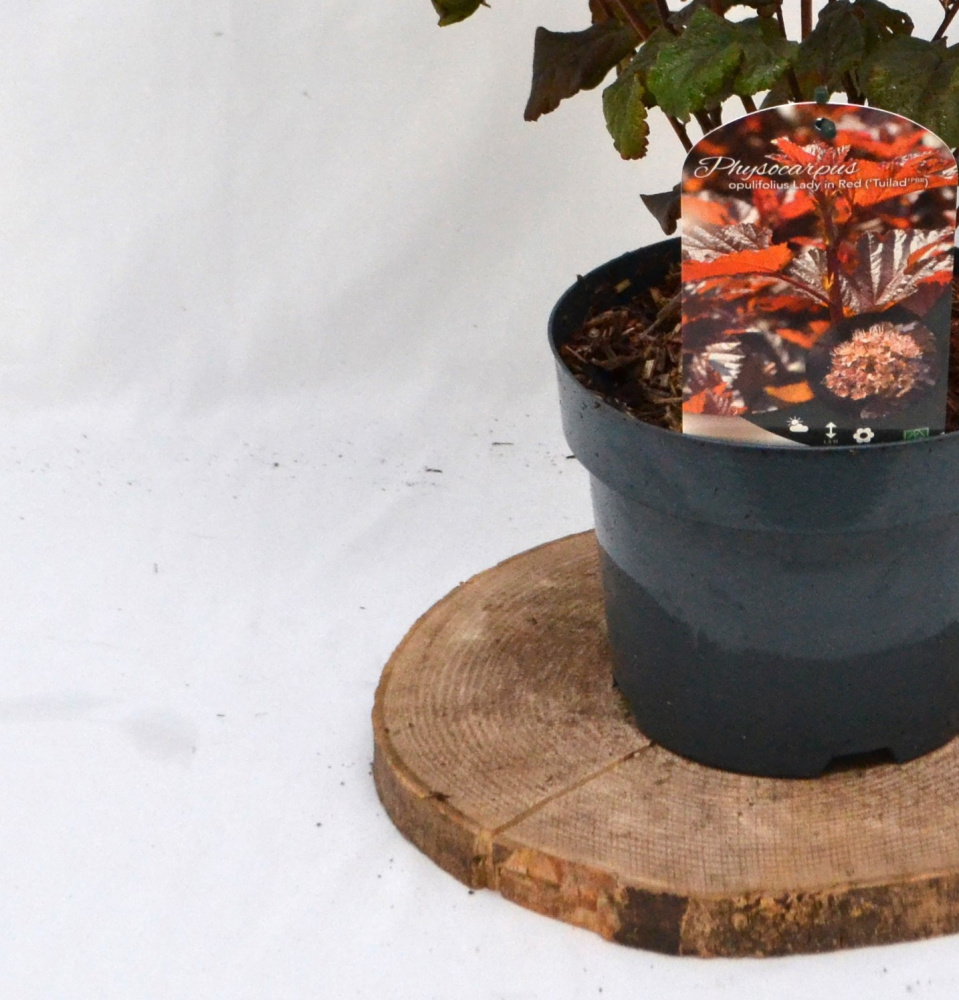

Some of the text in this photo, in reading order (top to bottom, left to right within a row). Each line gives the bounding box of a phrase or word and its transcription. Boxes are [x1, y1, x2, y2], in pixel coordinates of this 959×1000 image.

[693, 155, 858, 181] Physocarpus
[728, 179, 789, 191] opulifolius
[794, 179, 821, 193] Lady
[824, 180, 835, 189] in
[838, 178, 862, 189] Red
